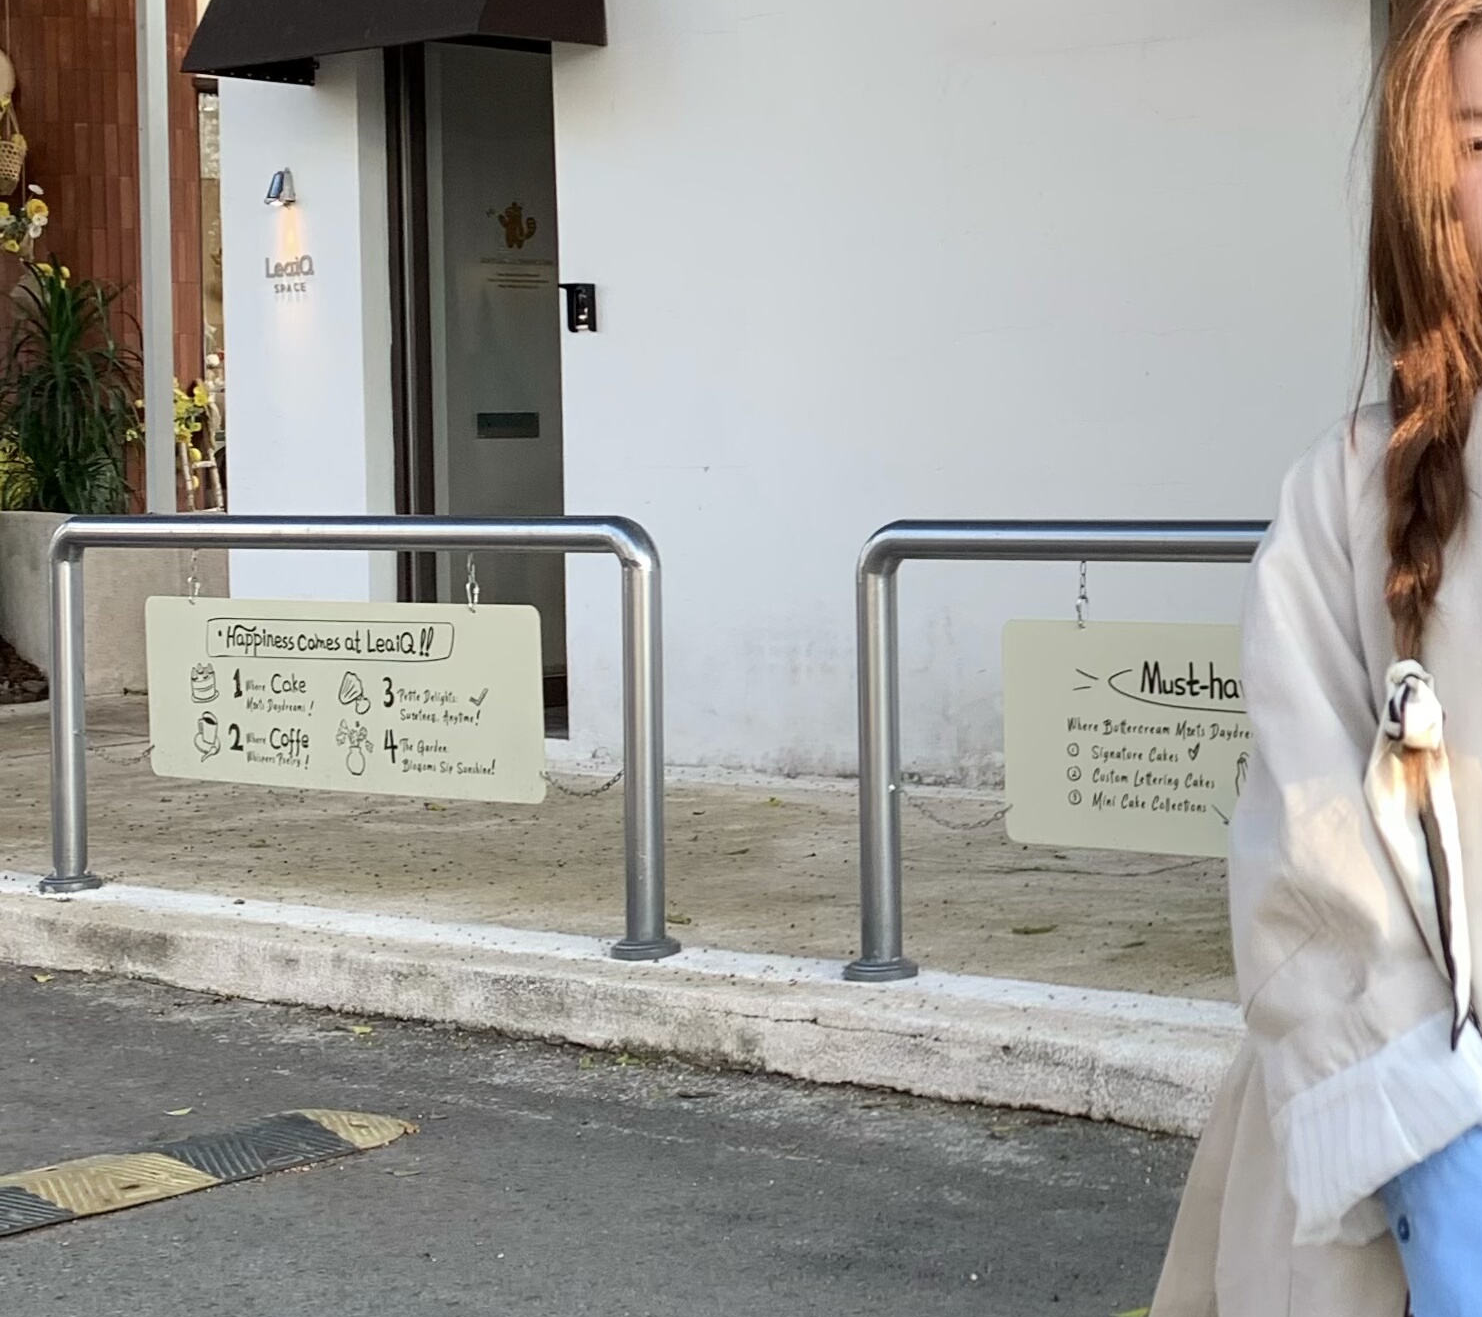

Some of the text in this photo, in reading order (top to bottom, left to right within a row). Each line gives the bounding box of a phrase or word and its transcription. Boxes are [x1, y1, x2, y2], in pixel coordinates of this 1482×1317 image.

[273, 282, 308, 295] SPACE
[226, 624, 296, 657] Happiness
[344, 629, 362, 654] at
[233, 668, 243, 698] 1
[270, 673, 307, 695] Cake
[383, 676, 395, 708] 3
[228, 723, 244, 751] 2
[269, 727, 310, 758] Coffe
[1066, 716, 1099, 733] Where
[1209, 723, 1254, 741] Daydre
[383, 729, 398, 764] 4
[1091, 745, 1143, 764] Signature
[1148, 746, 1179, 763] Cakes
[1092, 767, 1129, 784] Custom
[1133, 770, 1180, 791] Lettering
[1184, 772, 1216, 790] Cakes
[1091, 791, 1117, 811] Mini
[1120, 793, 1146, 810] Cake
[1151, 795, 1207, 813] Collections
